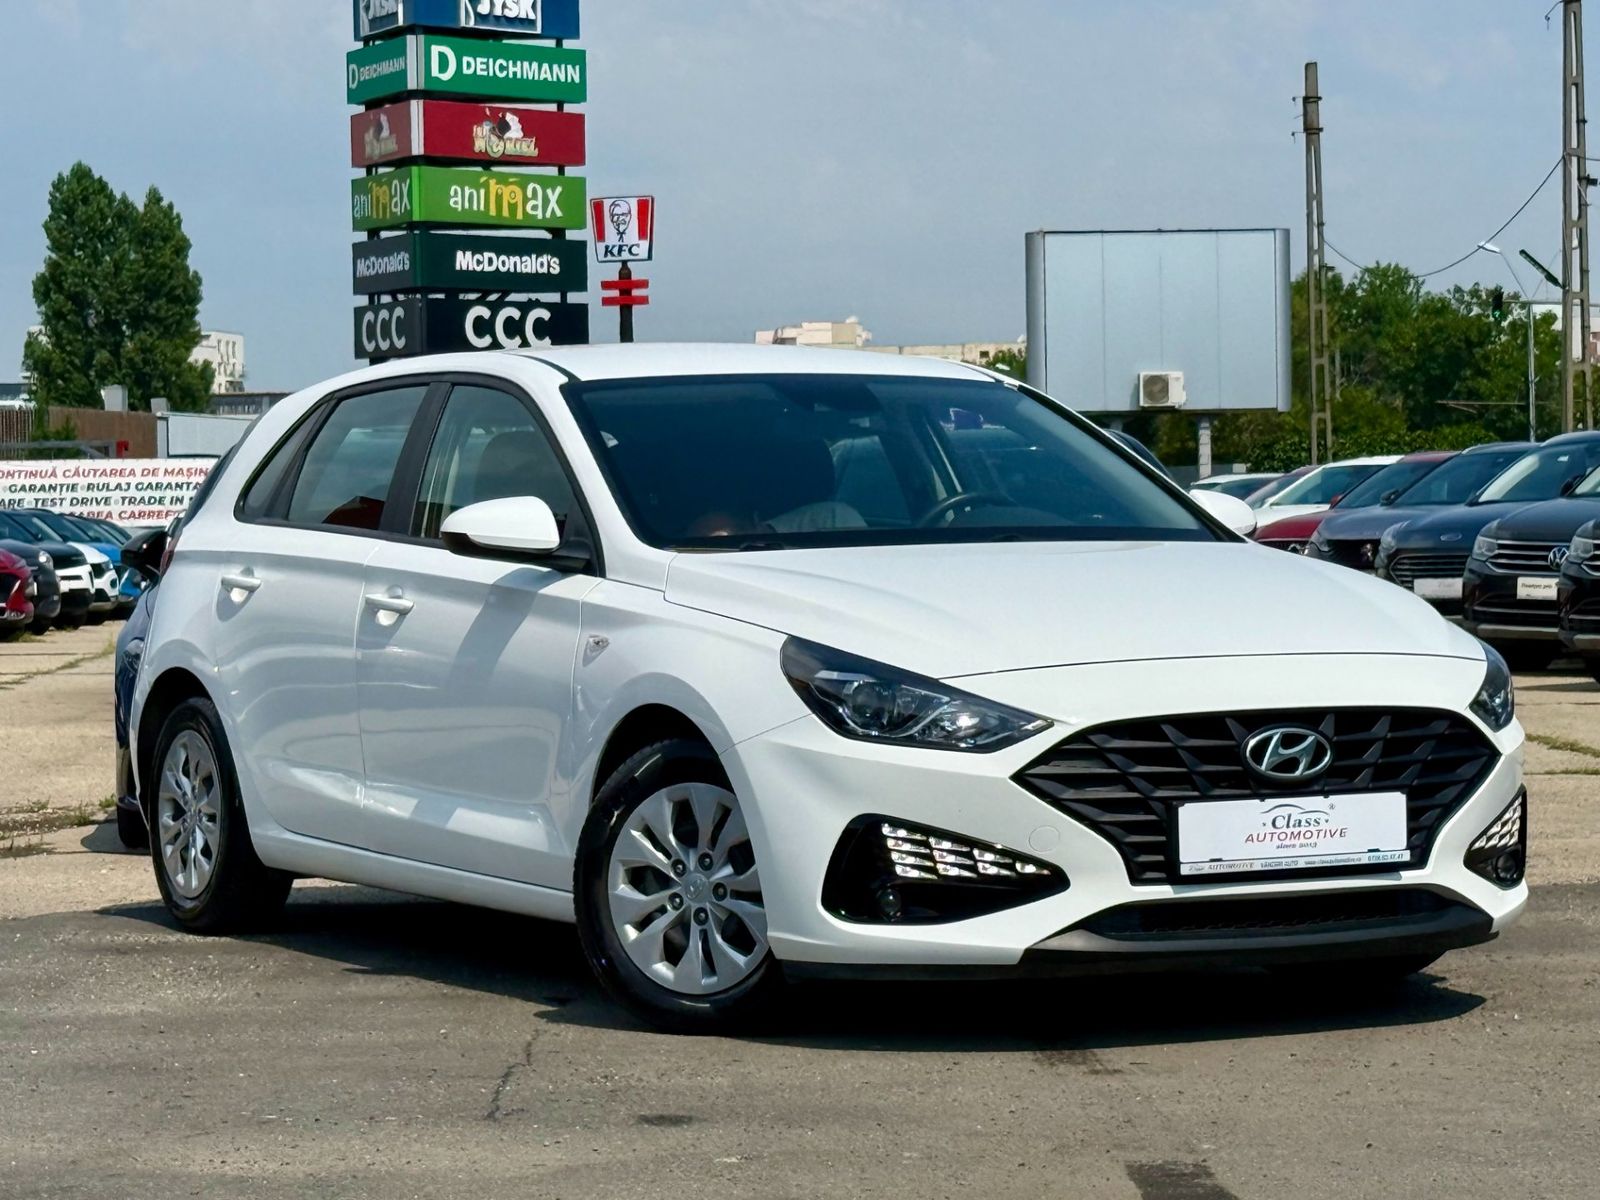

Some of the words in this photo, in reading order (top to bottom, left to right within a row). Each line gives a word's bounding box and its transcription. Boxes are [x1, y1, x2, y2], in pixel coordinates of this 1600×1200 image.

[360, 56, 405, 81] DEICHMANN
[431, 45, 457, 81] D
[462, 56, 580, 83] DEICHMANN
[449, 176, 563, 220] animax
[455, 250, 560, 275] McDonald's
[604, 244, 640, 258] KFC
[357, 251, 409, 277] McDonald's
[362, 307, 406, 352] CCC
[465, 305, 552, 349] CCC
[63, 466, 136, 478] CĂUTAREA
[141, 467, 160, 477] DE
[9, 483, 79, 495] GARANȚIE
[86, 482, 131, 491] RULAJ
[34, 498, 66, 507] TEST
[70, 496, 112, 507] DRIVE
[121, 496, 166, 506] TRADE
[170, 496, 184, 505] IN
[1271, 813, 1321, 829] Class
[1244, 827, 1348, 844] AUTOMOTIVE
